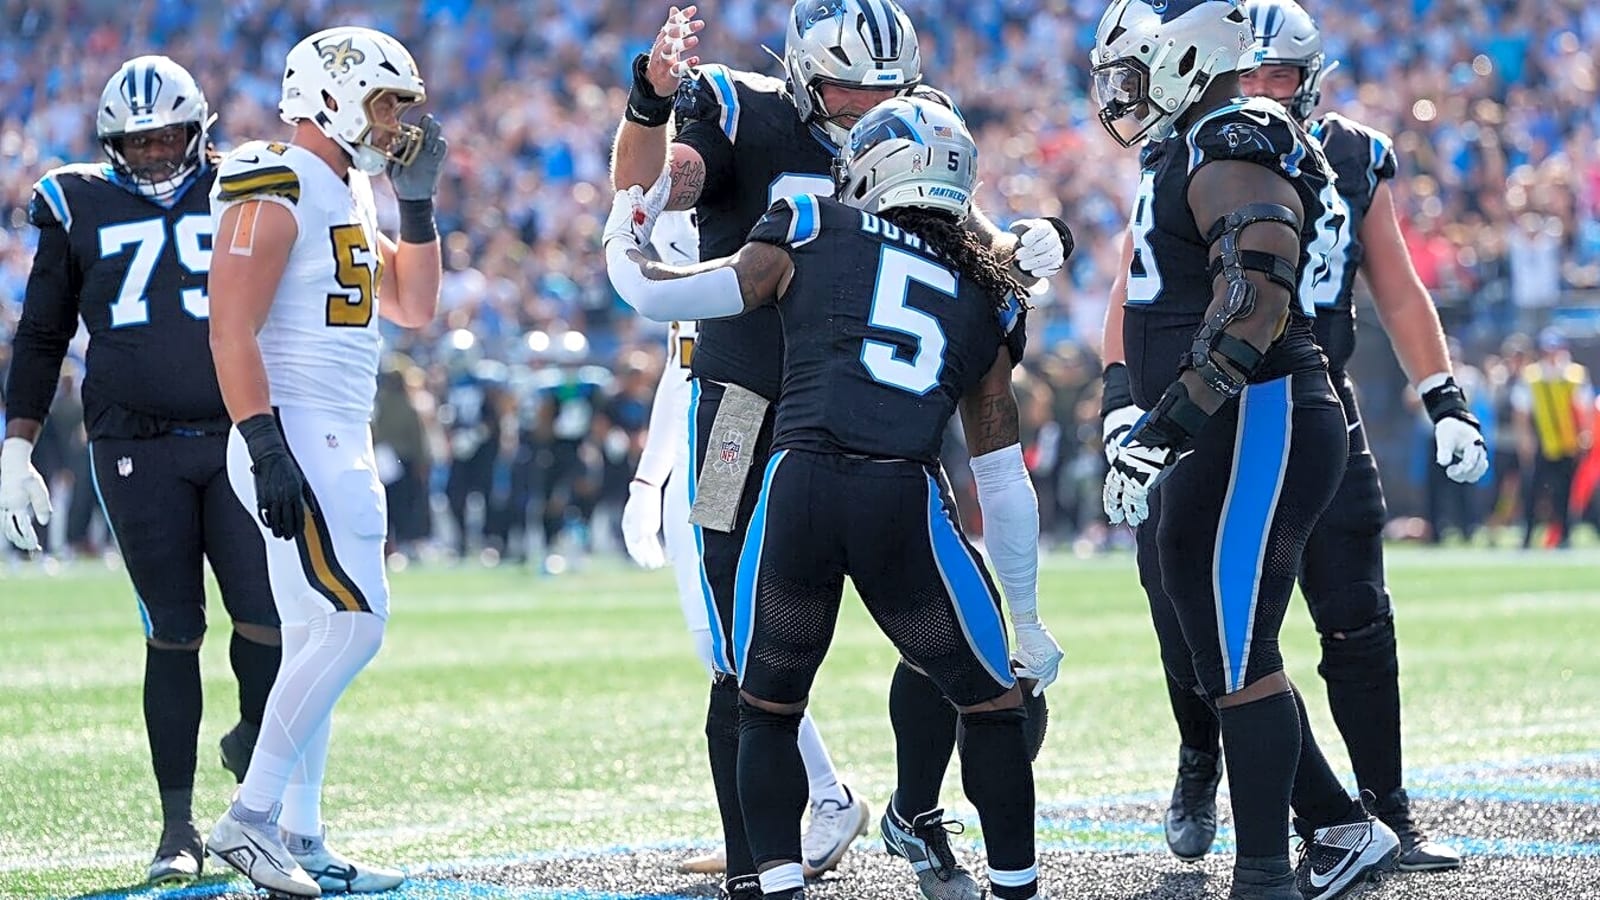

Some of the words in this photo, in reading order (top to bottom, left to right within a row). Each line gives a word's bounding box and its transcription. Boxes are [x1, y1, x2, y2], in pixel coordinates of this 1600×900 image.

[928, 187, 966, 204] PANTHERS
[947, 150, 960, 172] 5
[97, 212, 214, 328] 79
[326, 224, 384, 328] 5
[860, 243, 960, 396] 5
